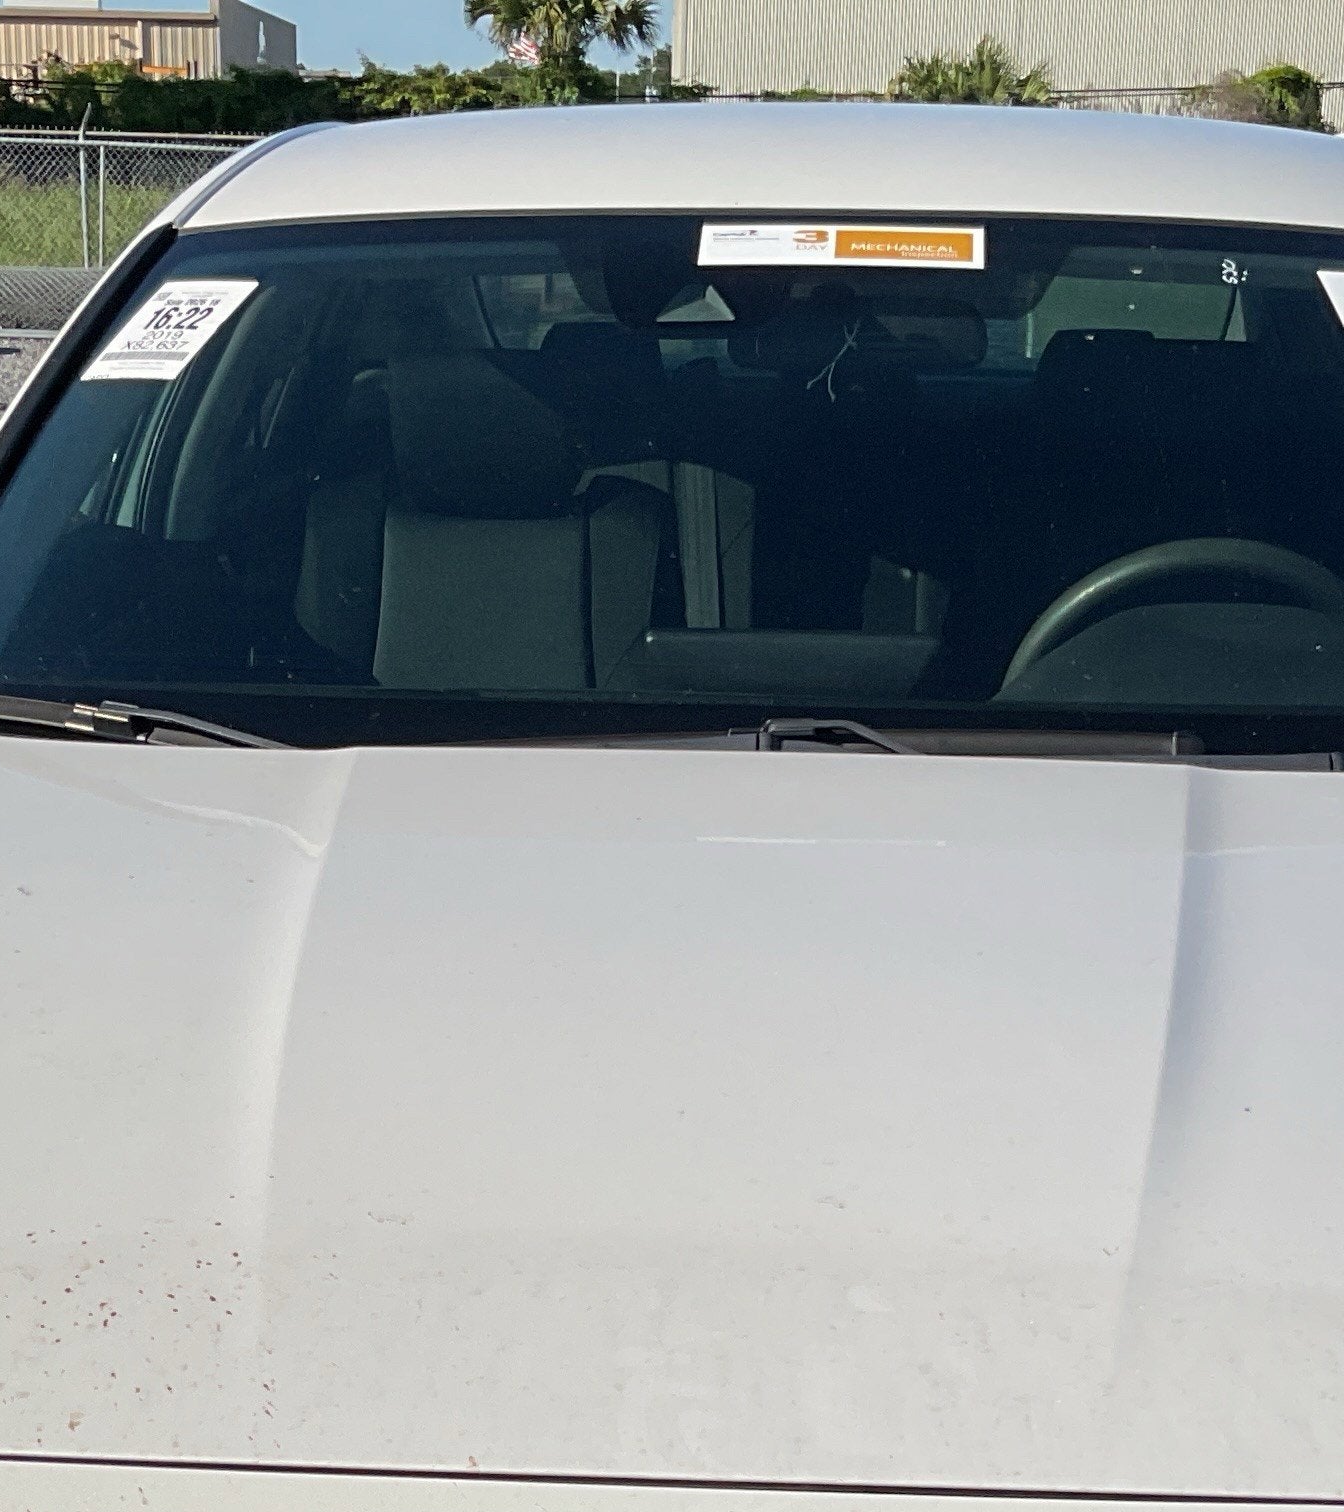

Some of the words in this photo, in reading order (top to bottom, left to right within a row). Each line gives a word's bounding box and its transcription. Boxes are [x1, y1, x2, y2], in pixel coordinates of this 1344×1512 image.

[792, 230, 830, 244] 3
[849, 242, 955, 253] MECHANICAL
[143, 306, 214, 330] 16:22
[142, 330, 184, 341] 2019
